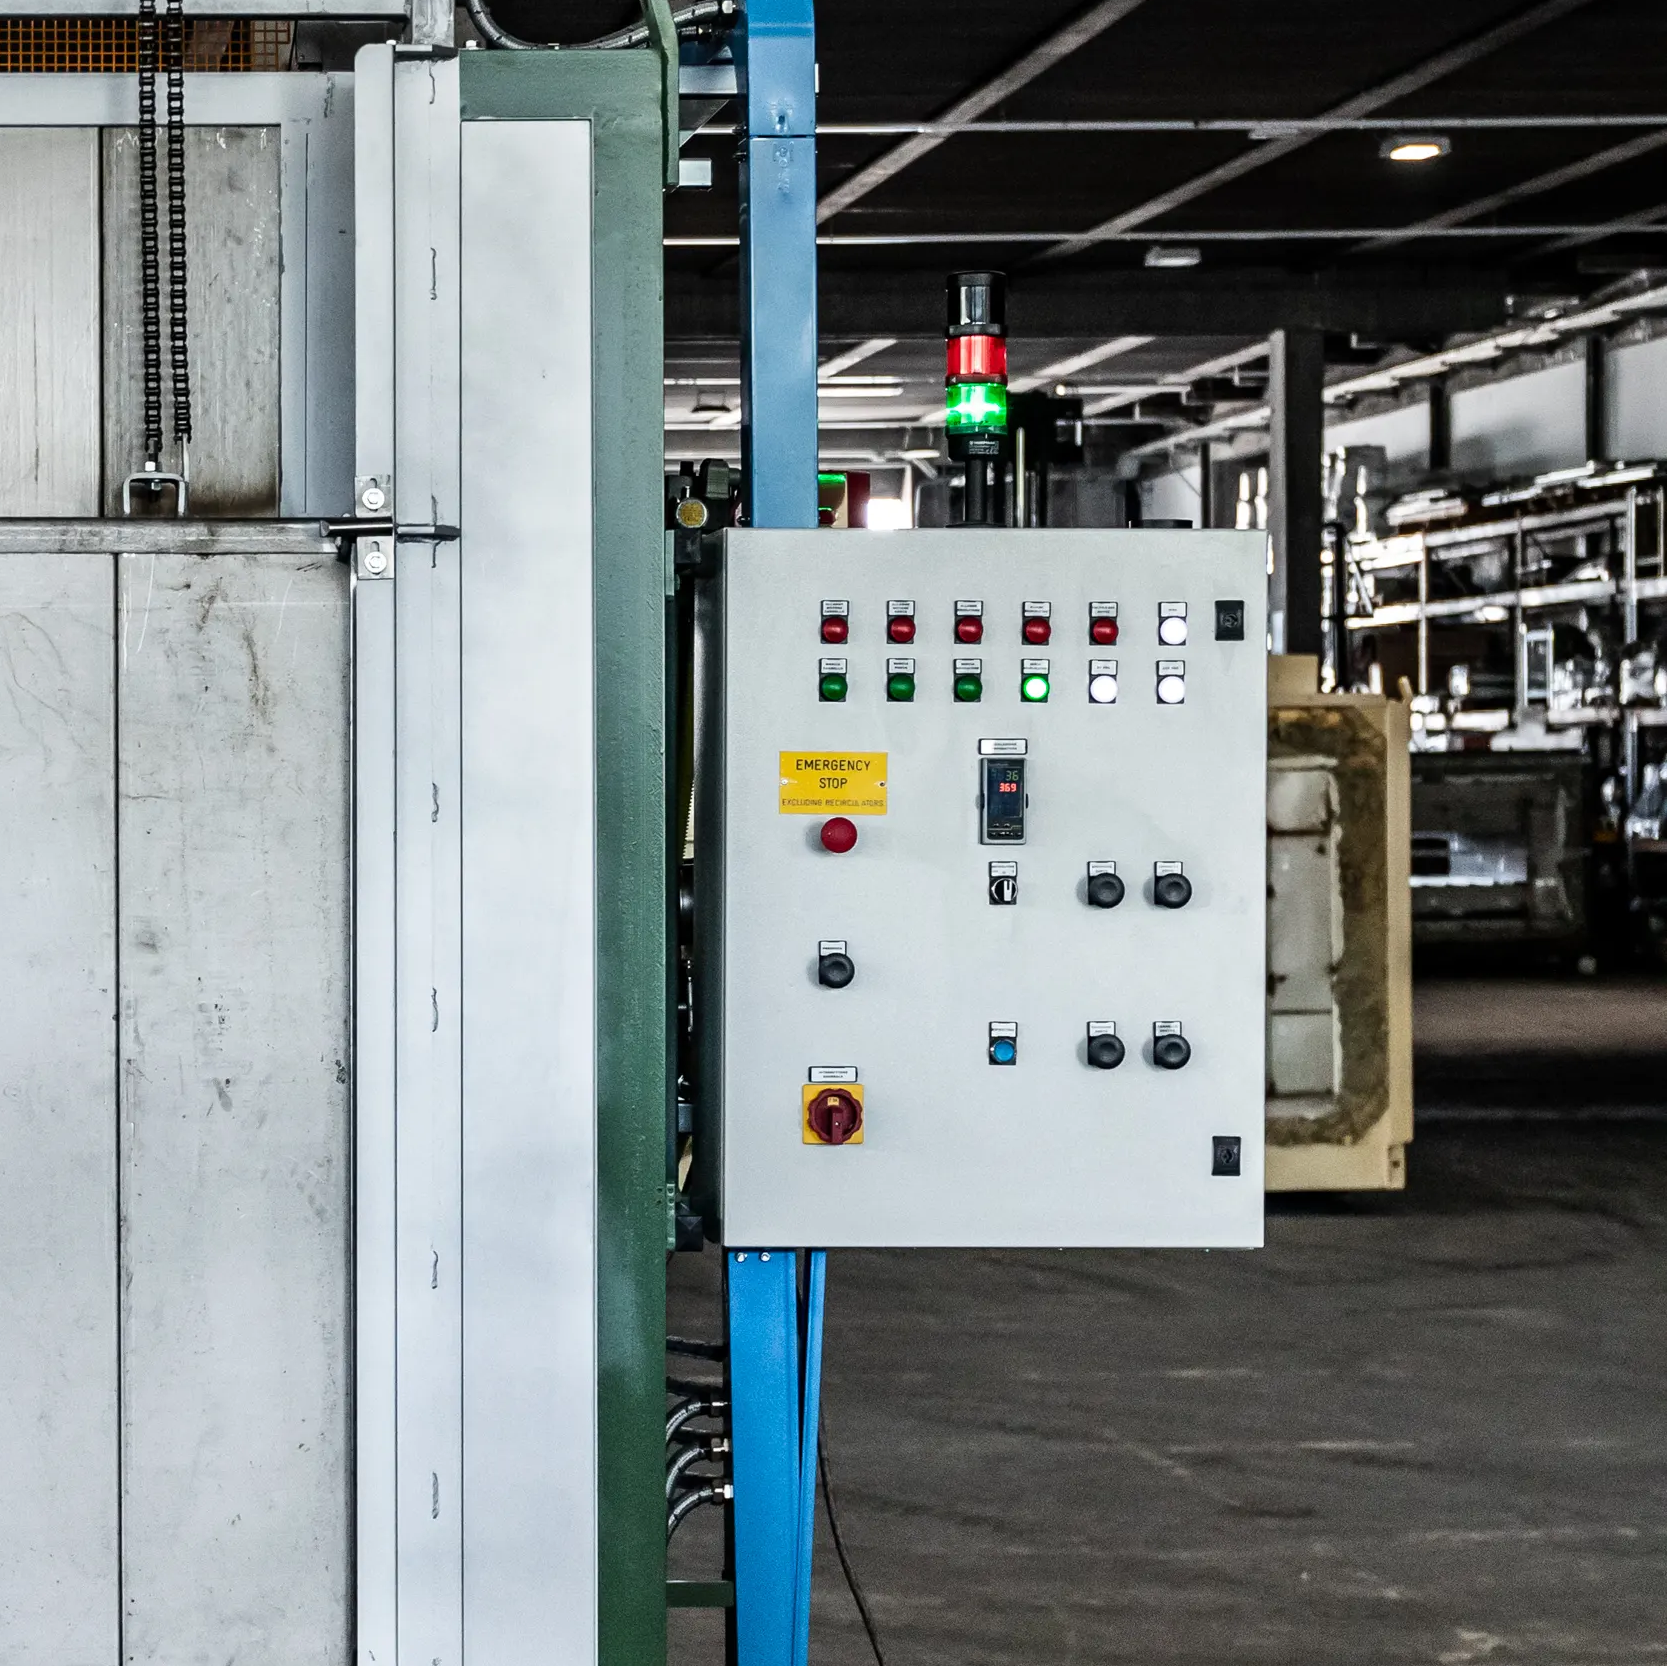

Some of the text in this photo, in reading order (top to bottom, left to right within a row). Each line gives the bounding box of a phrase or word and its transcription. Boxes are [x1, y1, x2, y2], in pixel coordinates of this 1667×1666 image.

[796, 759, 871, 771] EMERGENCY
[819, 777, 848, 789] STOP
[782, 798, 823, 806] EXCLUDING
